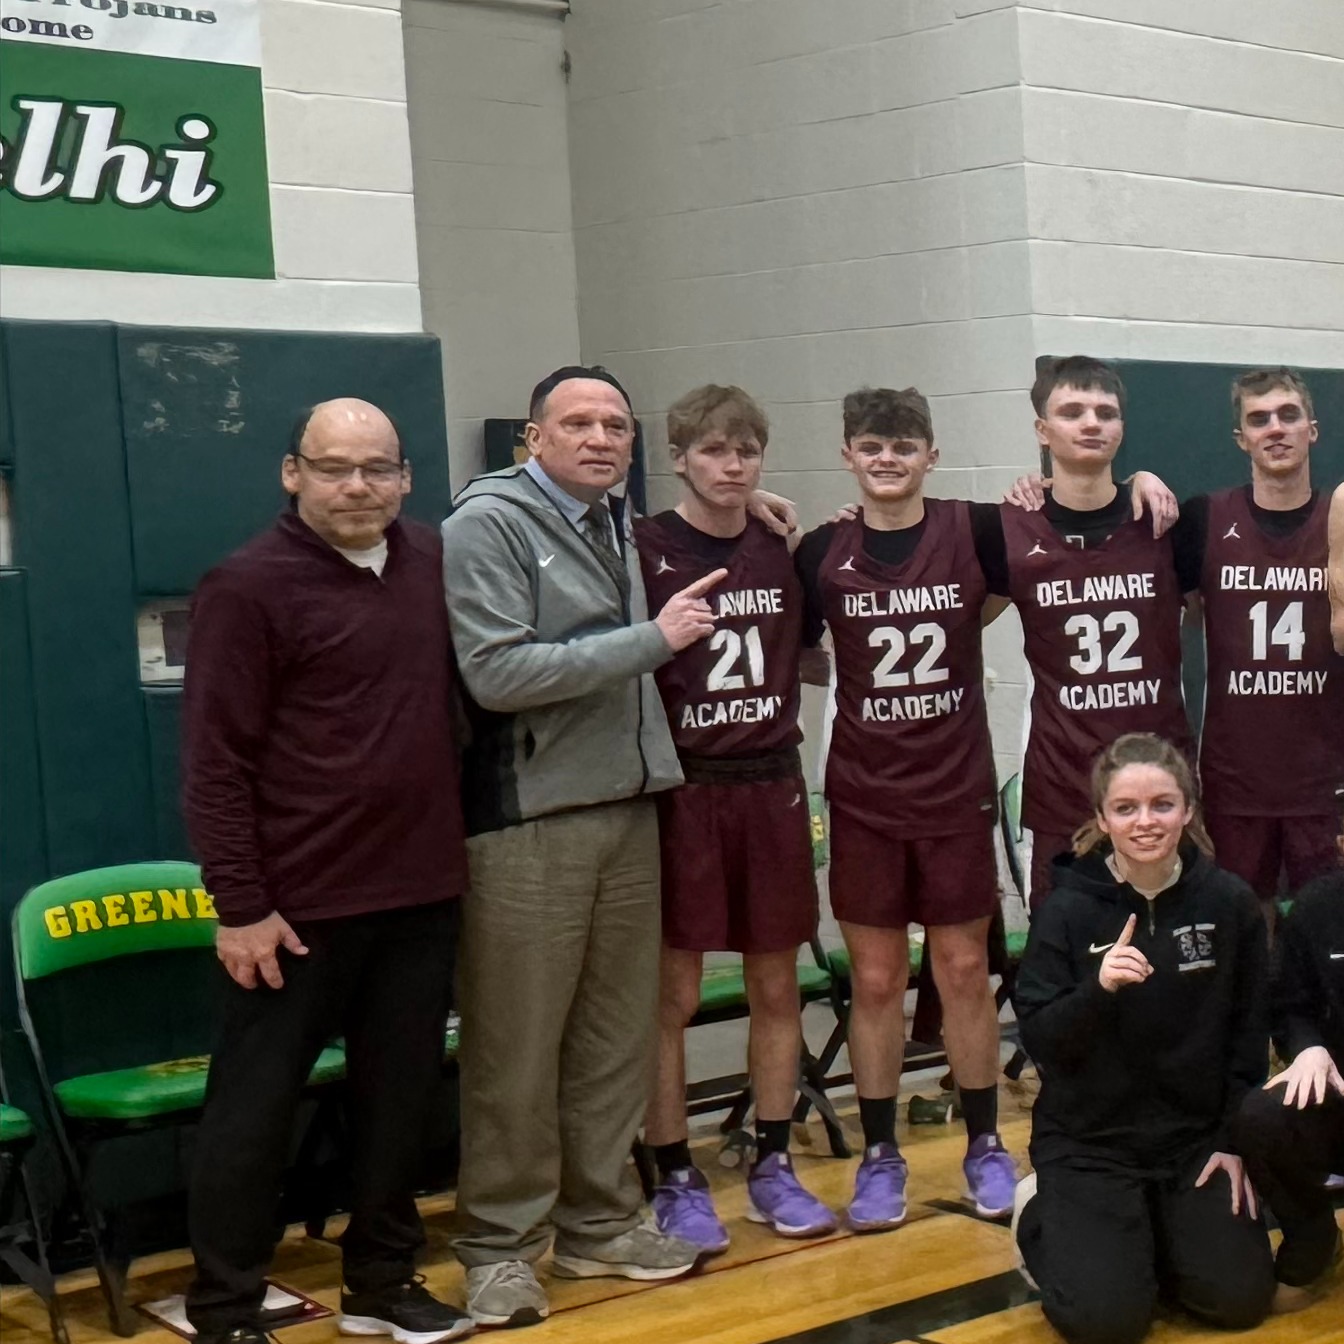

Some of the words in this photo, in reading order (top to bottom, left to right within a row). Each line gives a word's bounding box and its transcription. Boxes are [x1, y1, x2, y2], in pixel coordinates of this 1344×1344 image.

[0, 98, 218, 209] lhi
[843, 583, 963, 617] DELAWARE
[1036, 573, 1156, 607] DELAWARE
[1064, 610, 1143, 675] 32
[1249, 601, 1305, 661] 14
[706, 625, 765, 692] 21
[868, 622, 949, 688] 22
[1059, 679, 1161, 710] ACADEMY
[1228, 670, 1328, 695] ACADEMY
[681, 695, 787, 729] ACADEMY
[861, 688, 964, 722] ACADEMY
